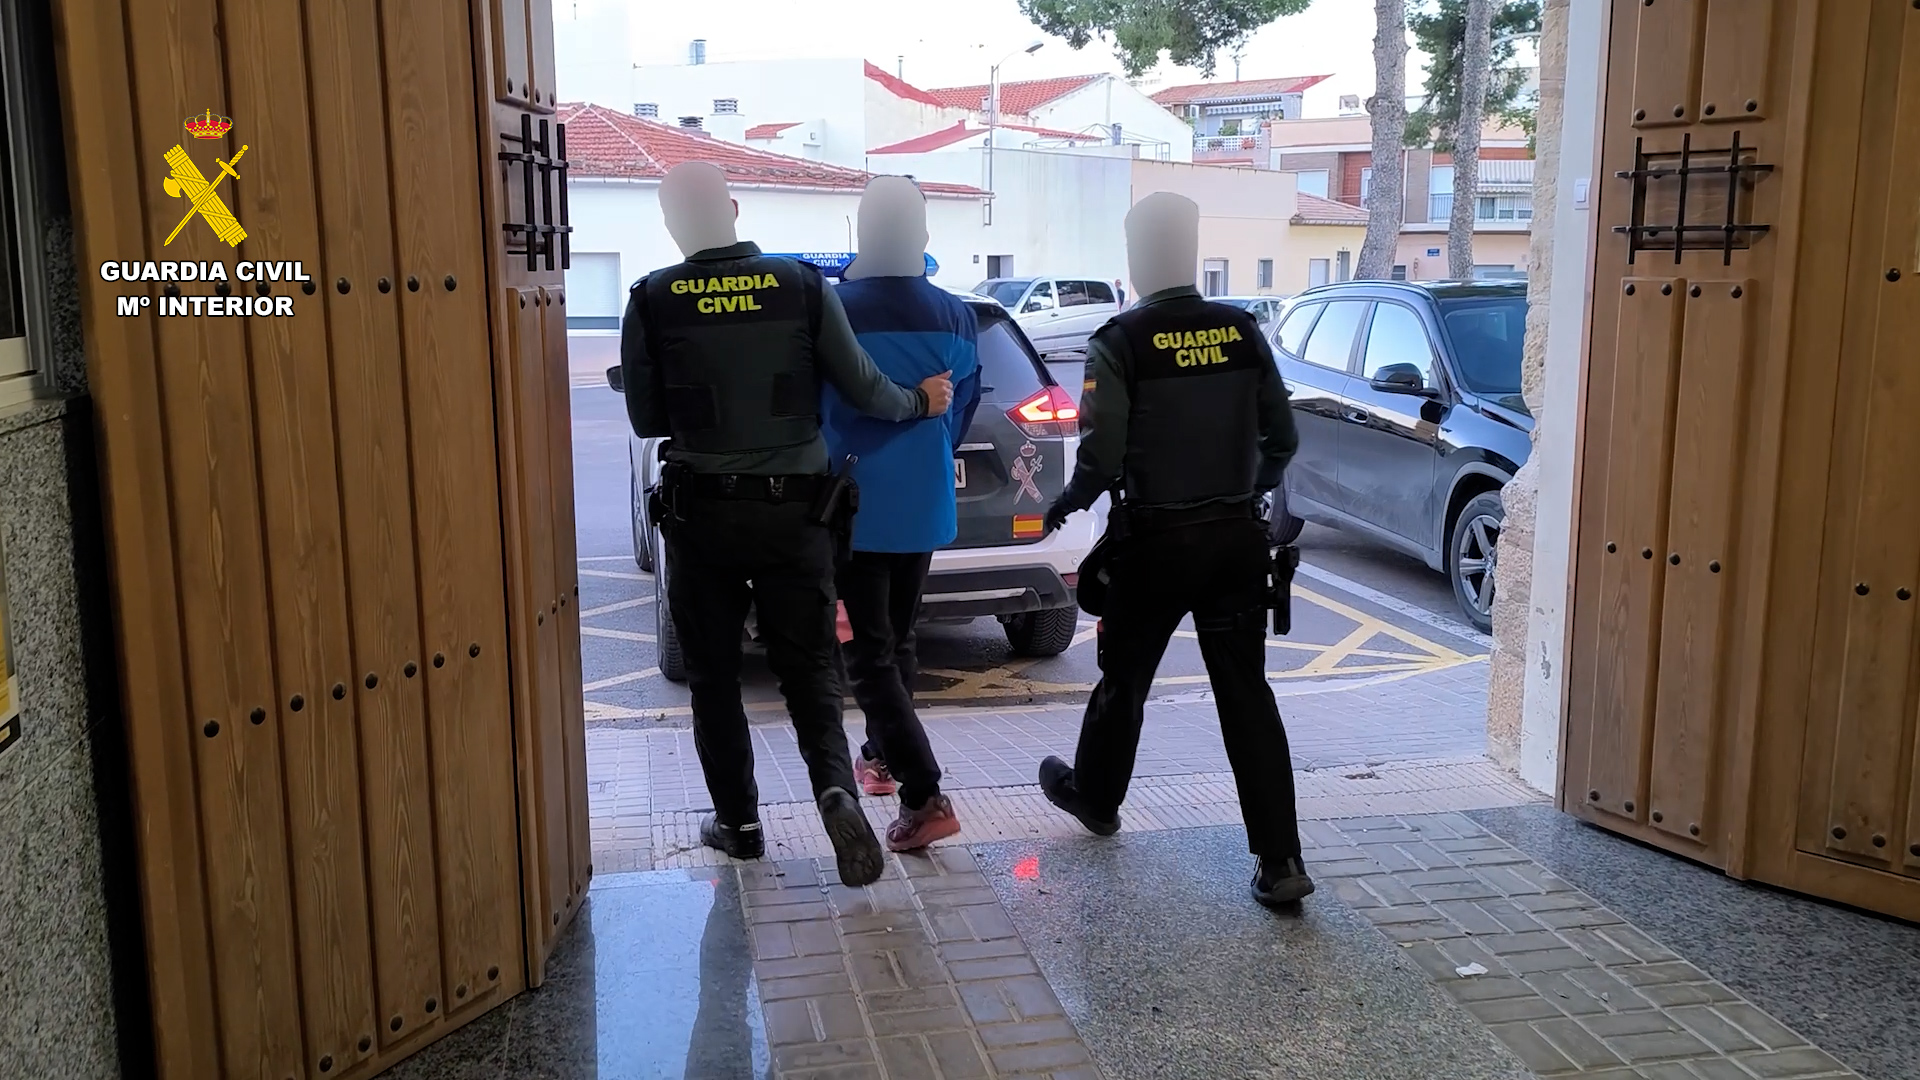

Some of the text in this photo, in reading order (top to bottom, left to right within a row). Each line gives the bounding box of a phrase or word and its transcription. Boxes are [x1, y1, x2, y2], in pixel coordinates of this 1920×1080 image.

[813, 259, 842, 267] CIVIL
[670, 273, 779, 294] GUARDIA
[697, 294, 761, 313] CIVIL
[1153, 326, 1242, 350] GUARDIA
[1175, 346, 1229, 367] CIVIL
